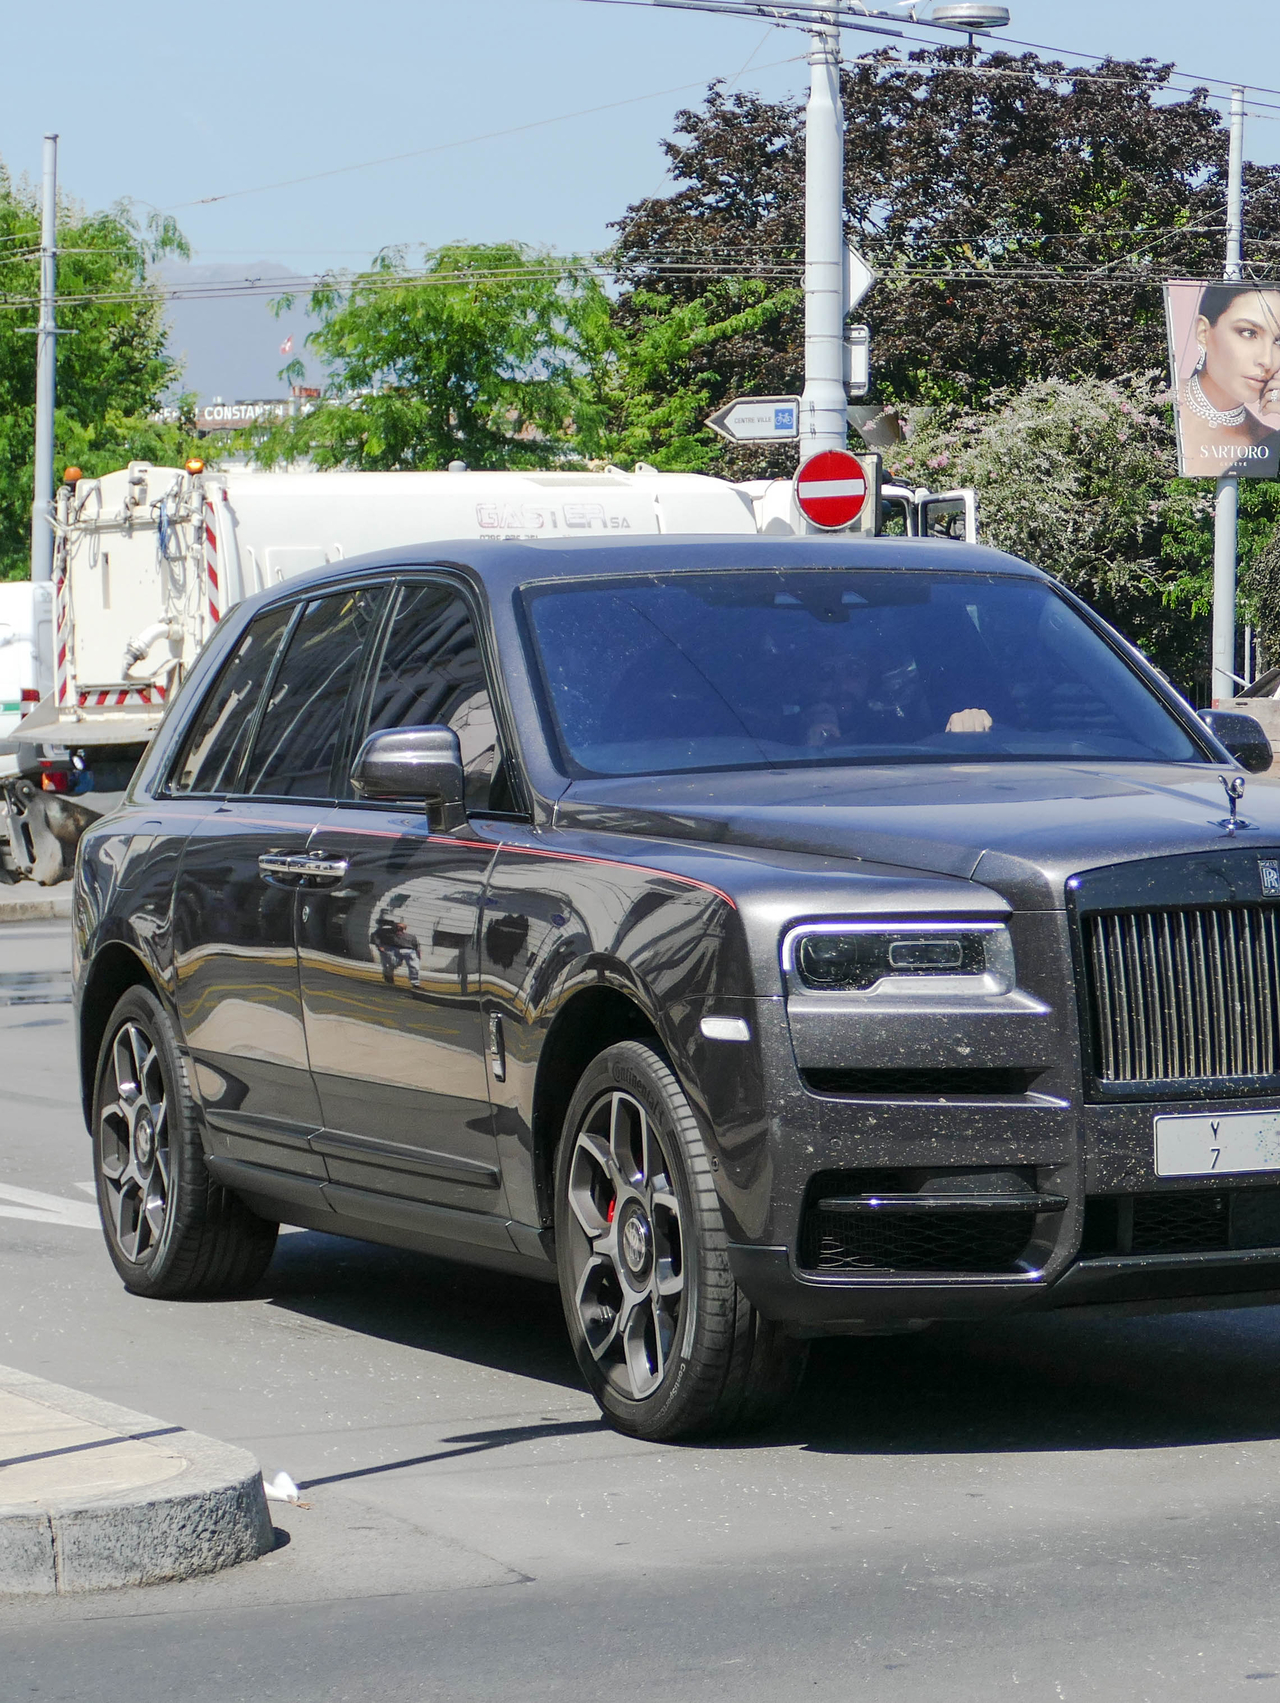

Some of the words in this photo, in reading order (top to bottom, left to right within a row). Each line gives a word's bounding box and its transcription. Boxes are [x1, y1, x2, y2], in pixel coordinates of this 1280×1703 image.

[1200, 445, 1269, 459] SARTORO
[610, 517, 631, 528] SA
[1210, 1147, 1220, 1170] 7
